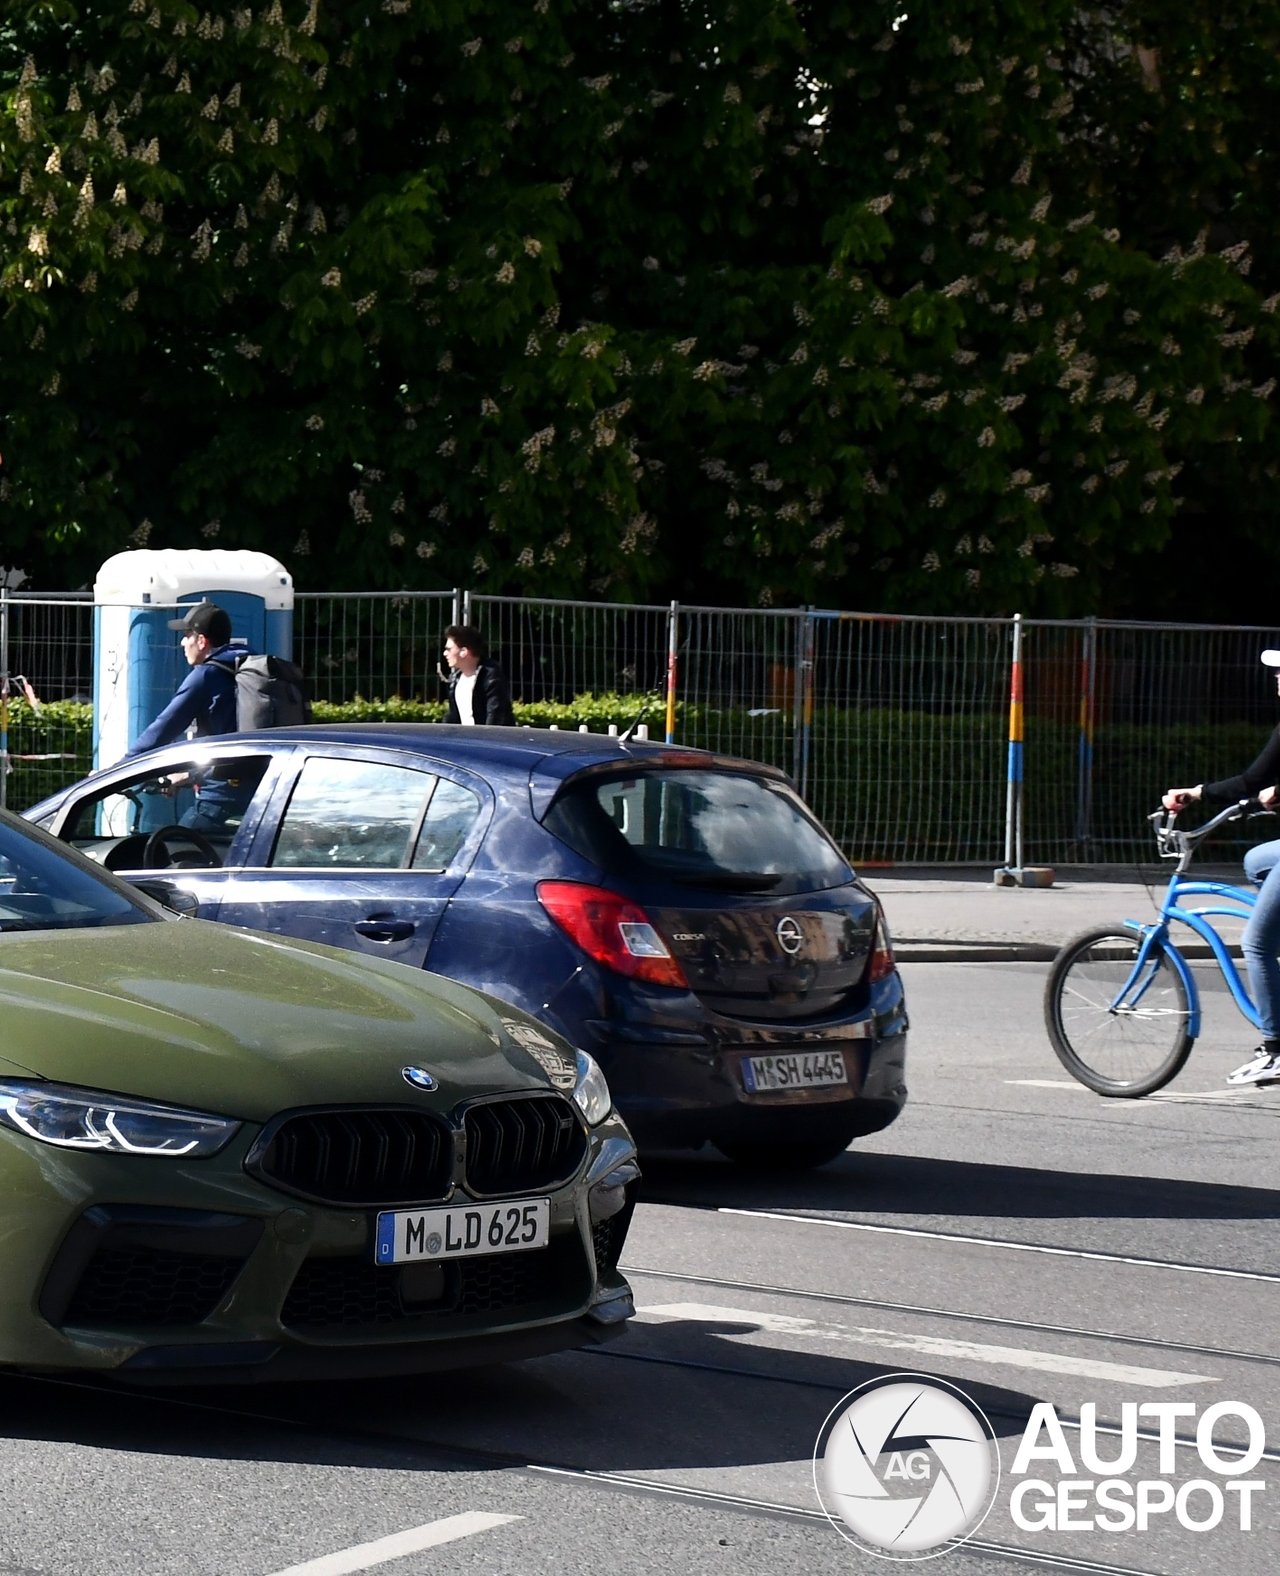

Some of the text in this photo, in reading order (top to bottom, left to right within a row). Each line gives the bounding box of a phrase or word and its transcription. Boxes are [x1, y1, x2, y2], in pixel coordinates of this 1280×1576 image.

[752, 1053, 844, 1086] M SH 4445
[405, 1205, 538, 1255] M LD 625
[382, 1243, 389, 1255] D
